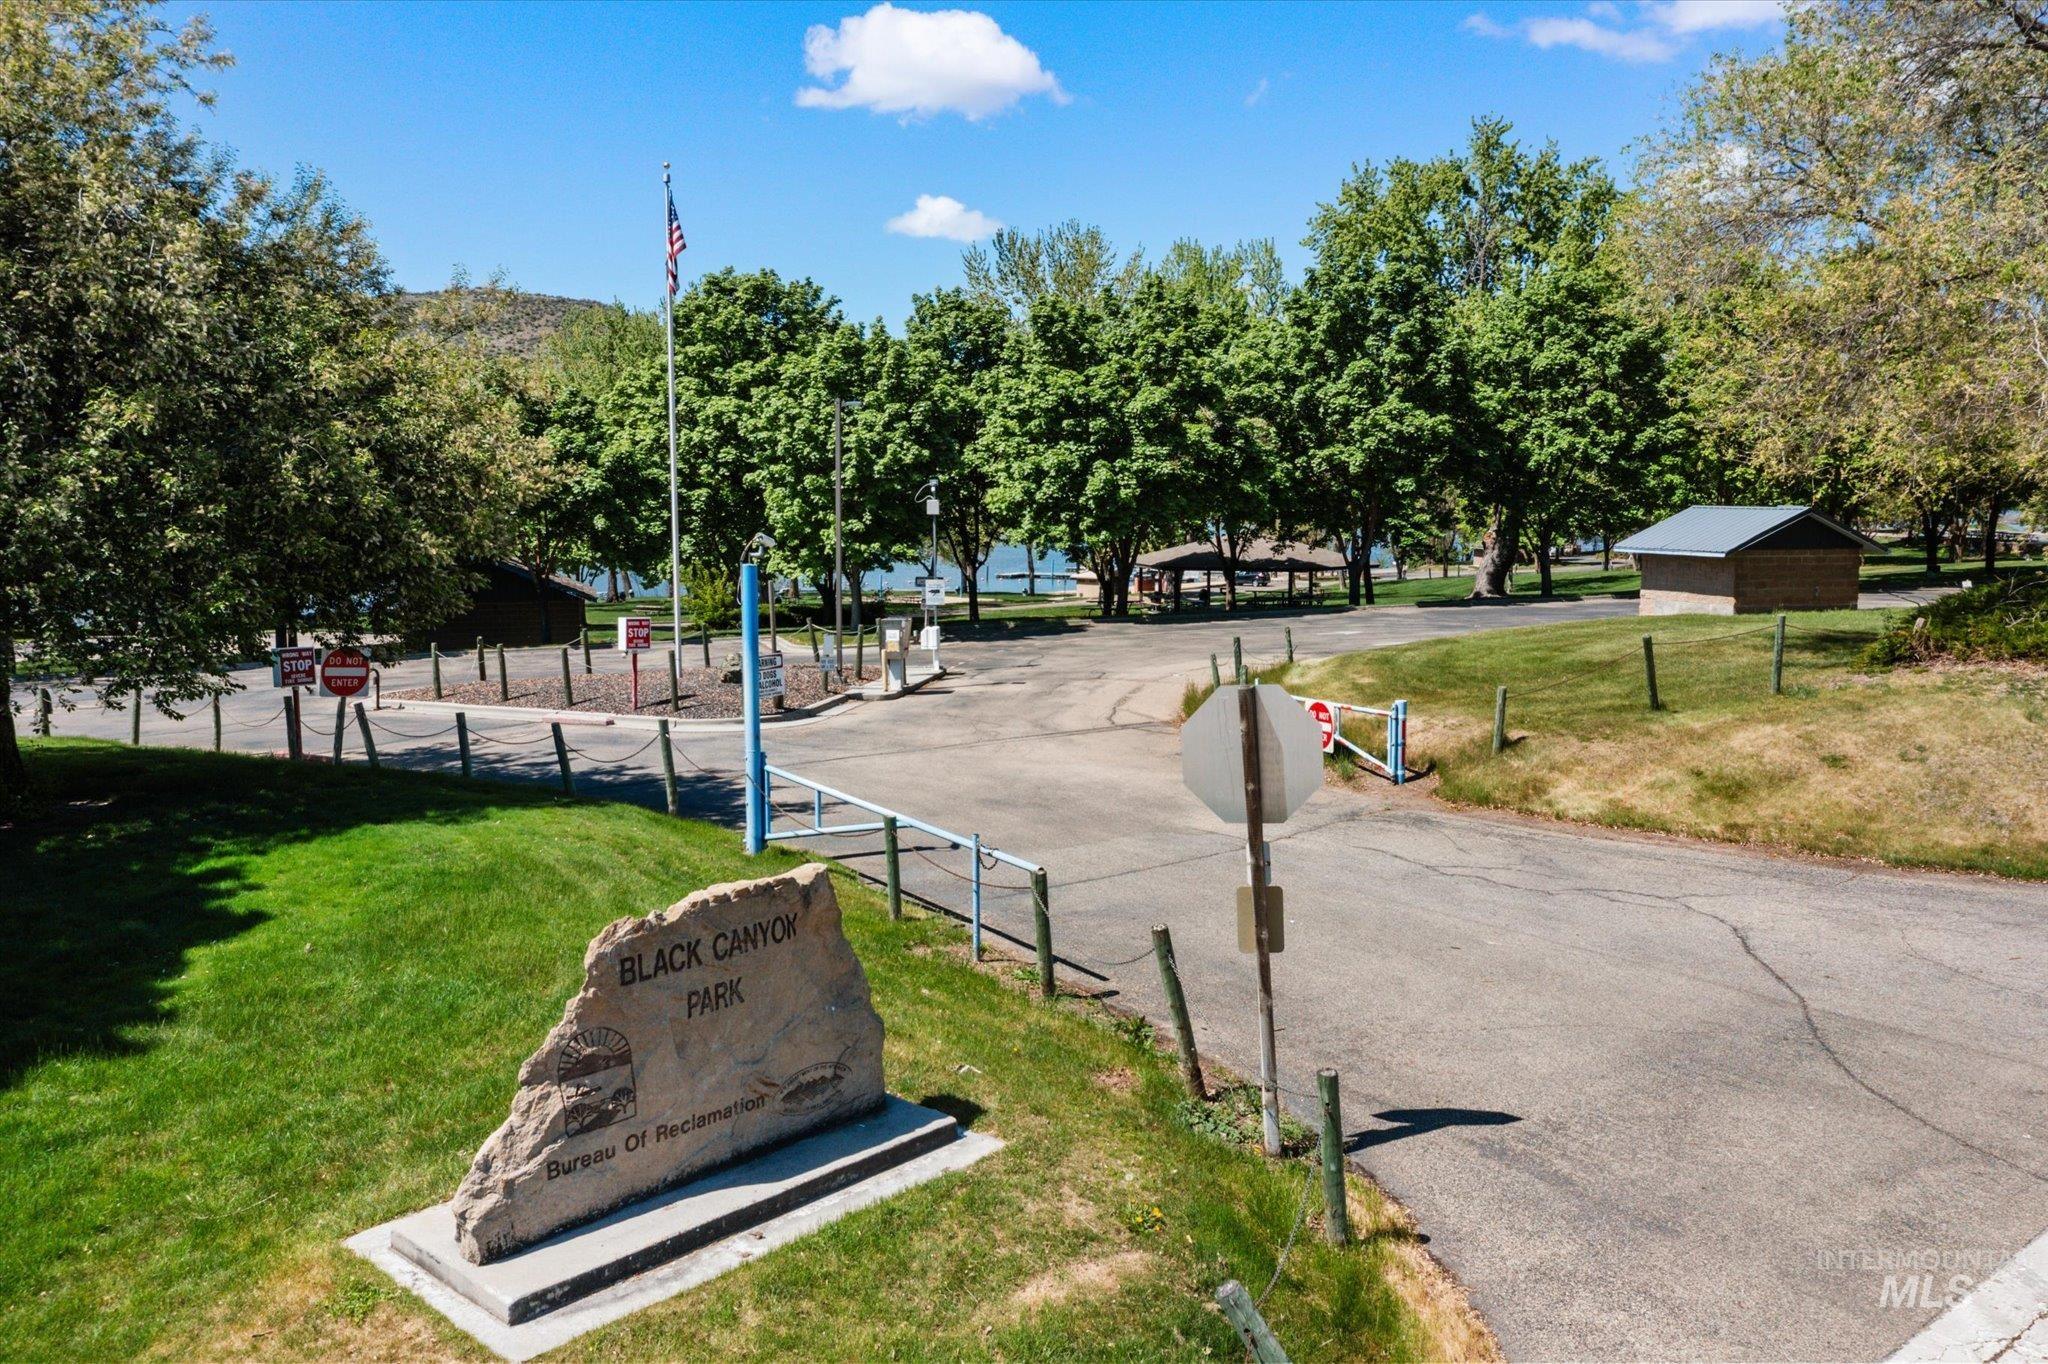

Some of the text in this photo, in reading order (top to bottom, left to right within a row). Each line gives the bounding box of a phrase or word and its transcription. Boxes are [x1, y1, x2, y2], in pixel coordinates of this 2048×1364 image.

[628, 628, 648, 637] STOP
[283, 660, 312, 672] STOP
[329, 657, 363, 665] DO NOT
[758, 657, 777, 668] ARNING
[763, 670, 777, 679] DOGS
[331, 679, 359, 687] ENTER
[1318, 711, 1330, 721] NOT
[619, 912, 798, 987] BLACK CANYON
[687, 976, 745, 1019] PARK
[546, 1144, 616, 1181] Bureau
[624, 1129, 648, 1153] Of
[655, 1094, 765, 1143] Reclamation
